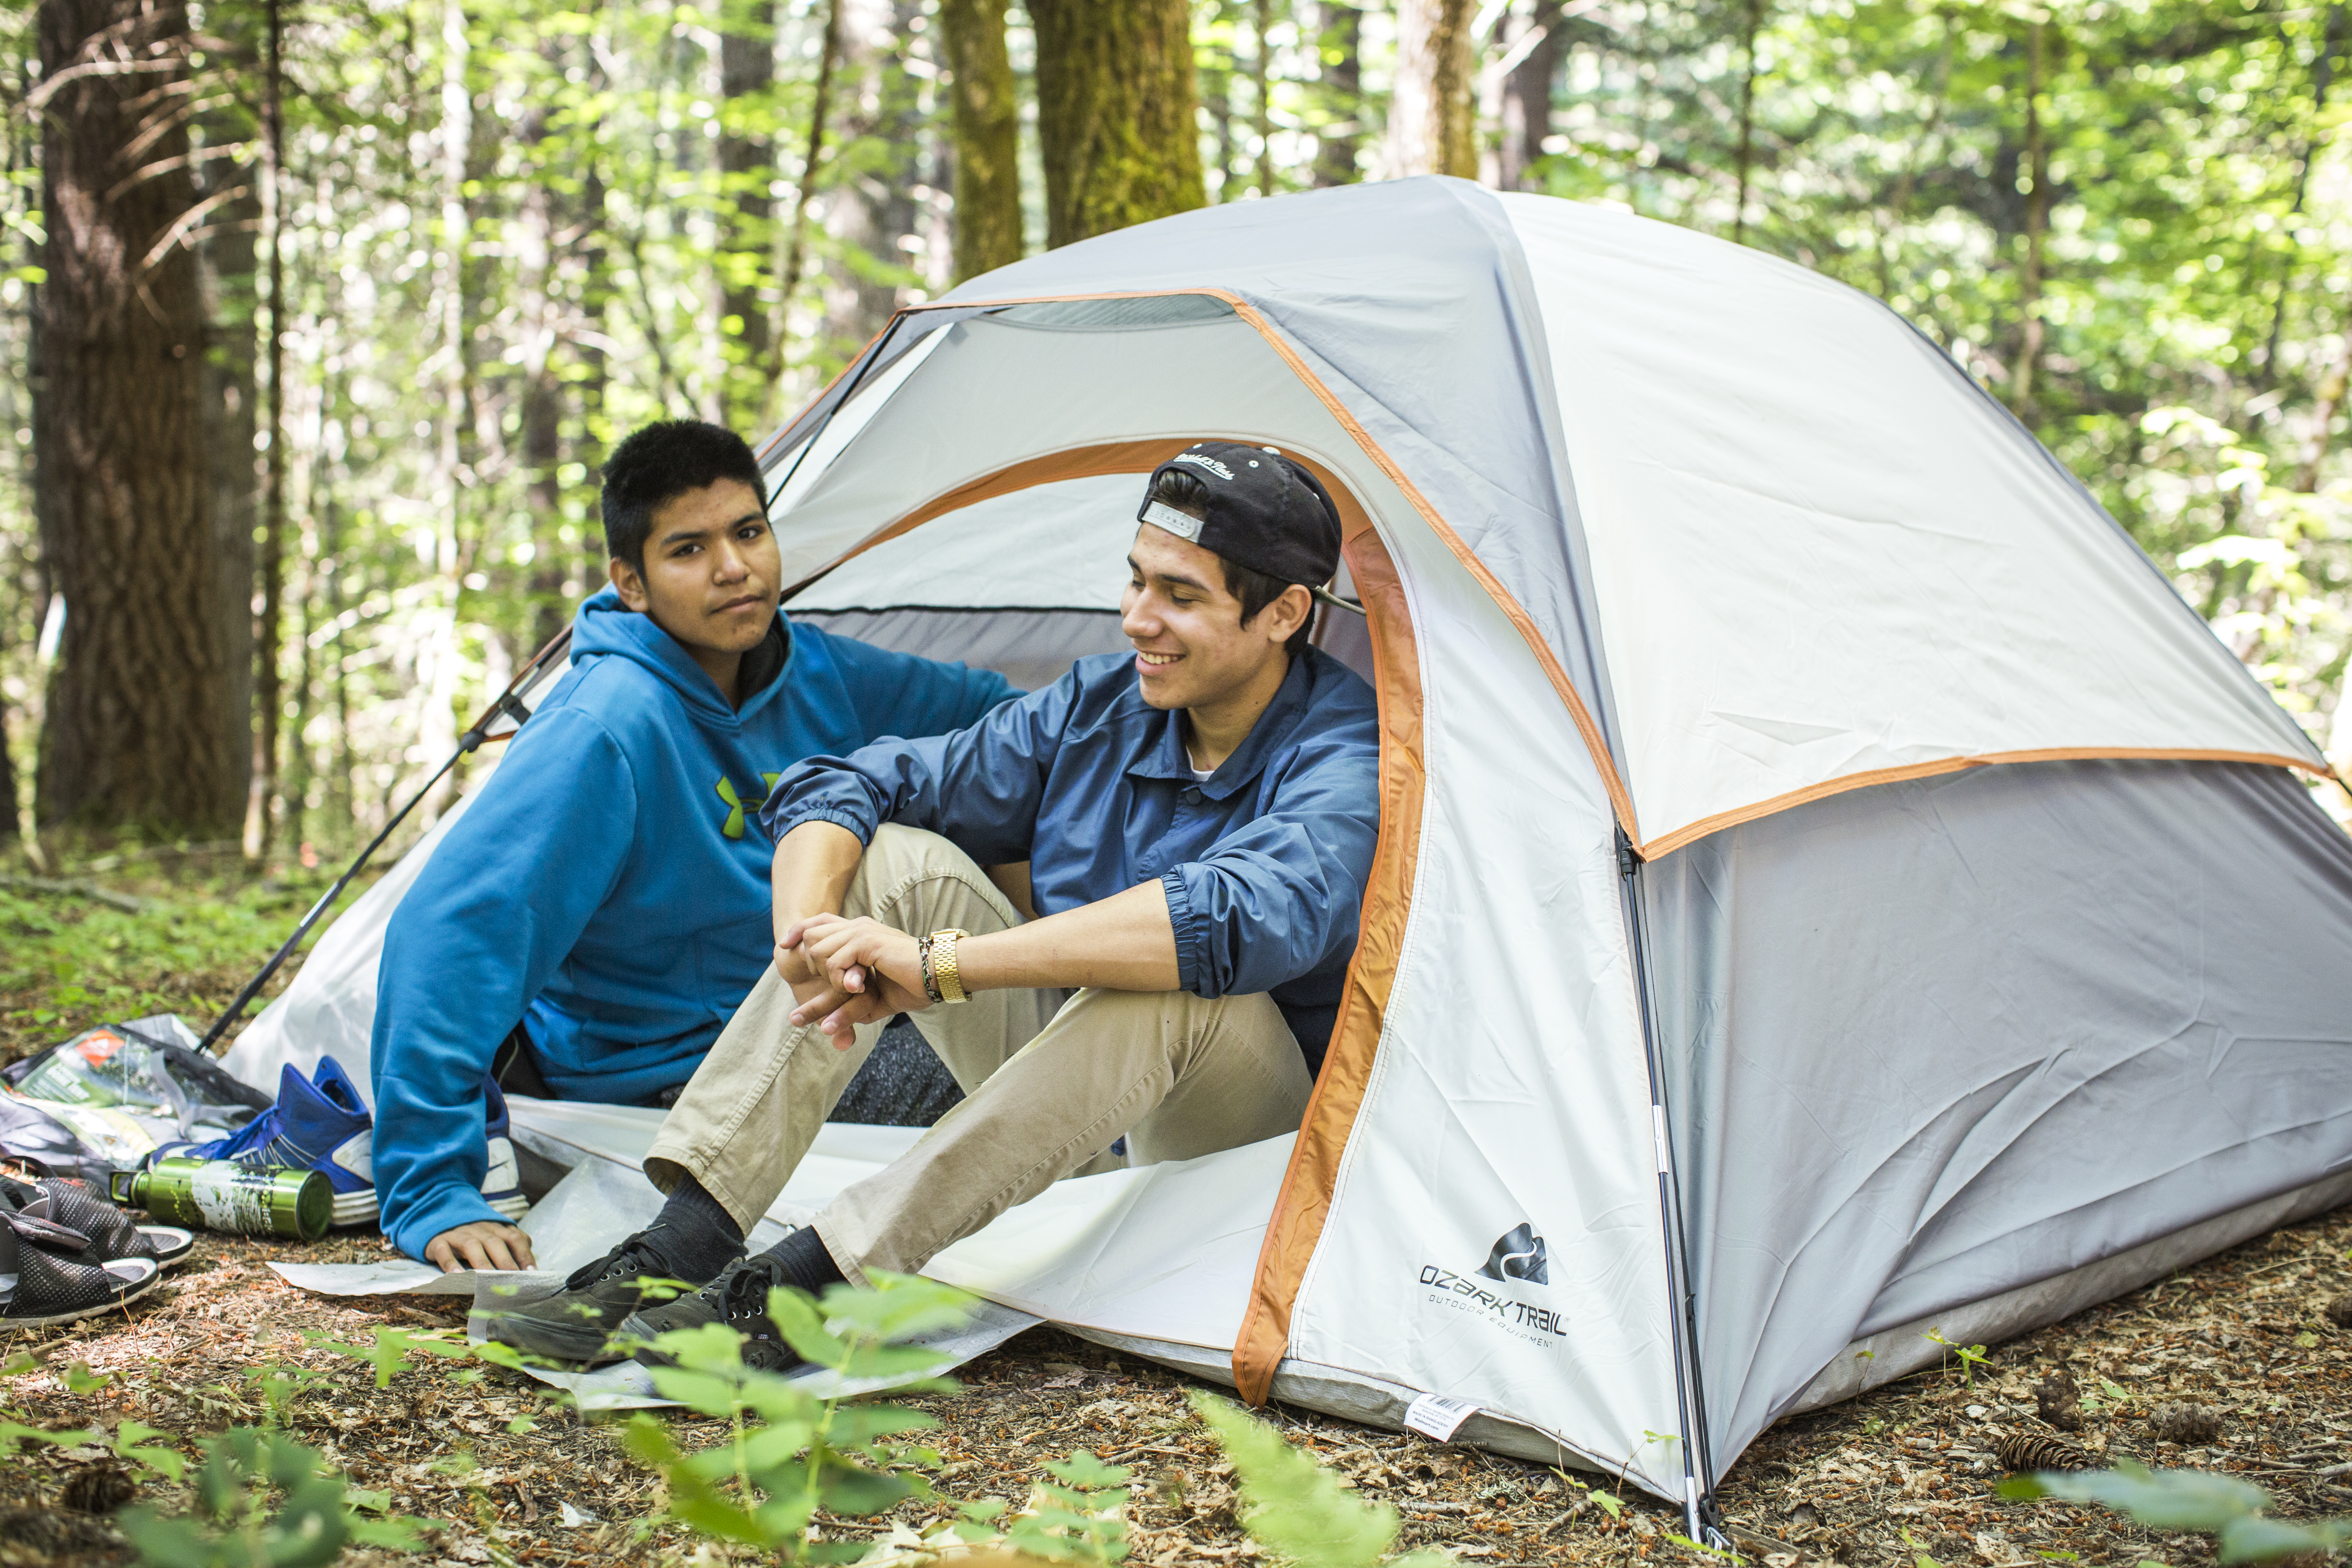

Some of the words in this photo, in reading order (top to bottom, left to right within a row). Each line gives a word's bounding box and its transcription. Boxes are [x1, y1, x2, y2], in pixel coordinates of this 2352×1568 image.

[1420, 1265, 1514, 1317] OZARK
[1516, 1302, 1567, 1337] TRAIL
[1429, 1294, 1484, 1315] OUTDOOR
[1489, 1317, 1553, 1349] EQUIPMENT
[1414, 1417, 1439, 1430] Walmart.com
[1426, 1416, 1449, 1428] BANGLADESH
